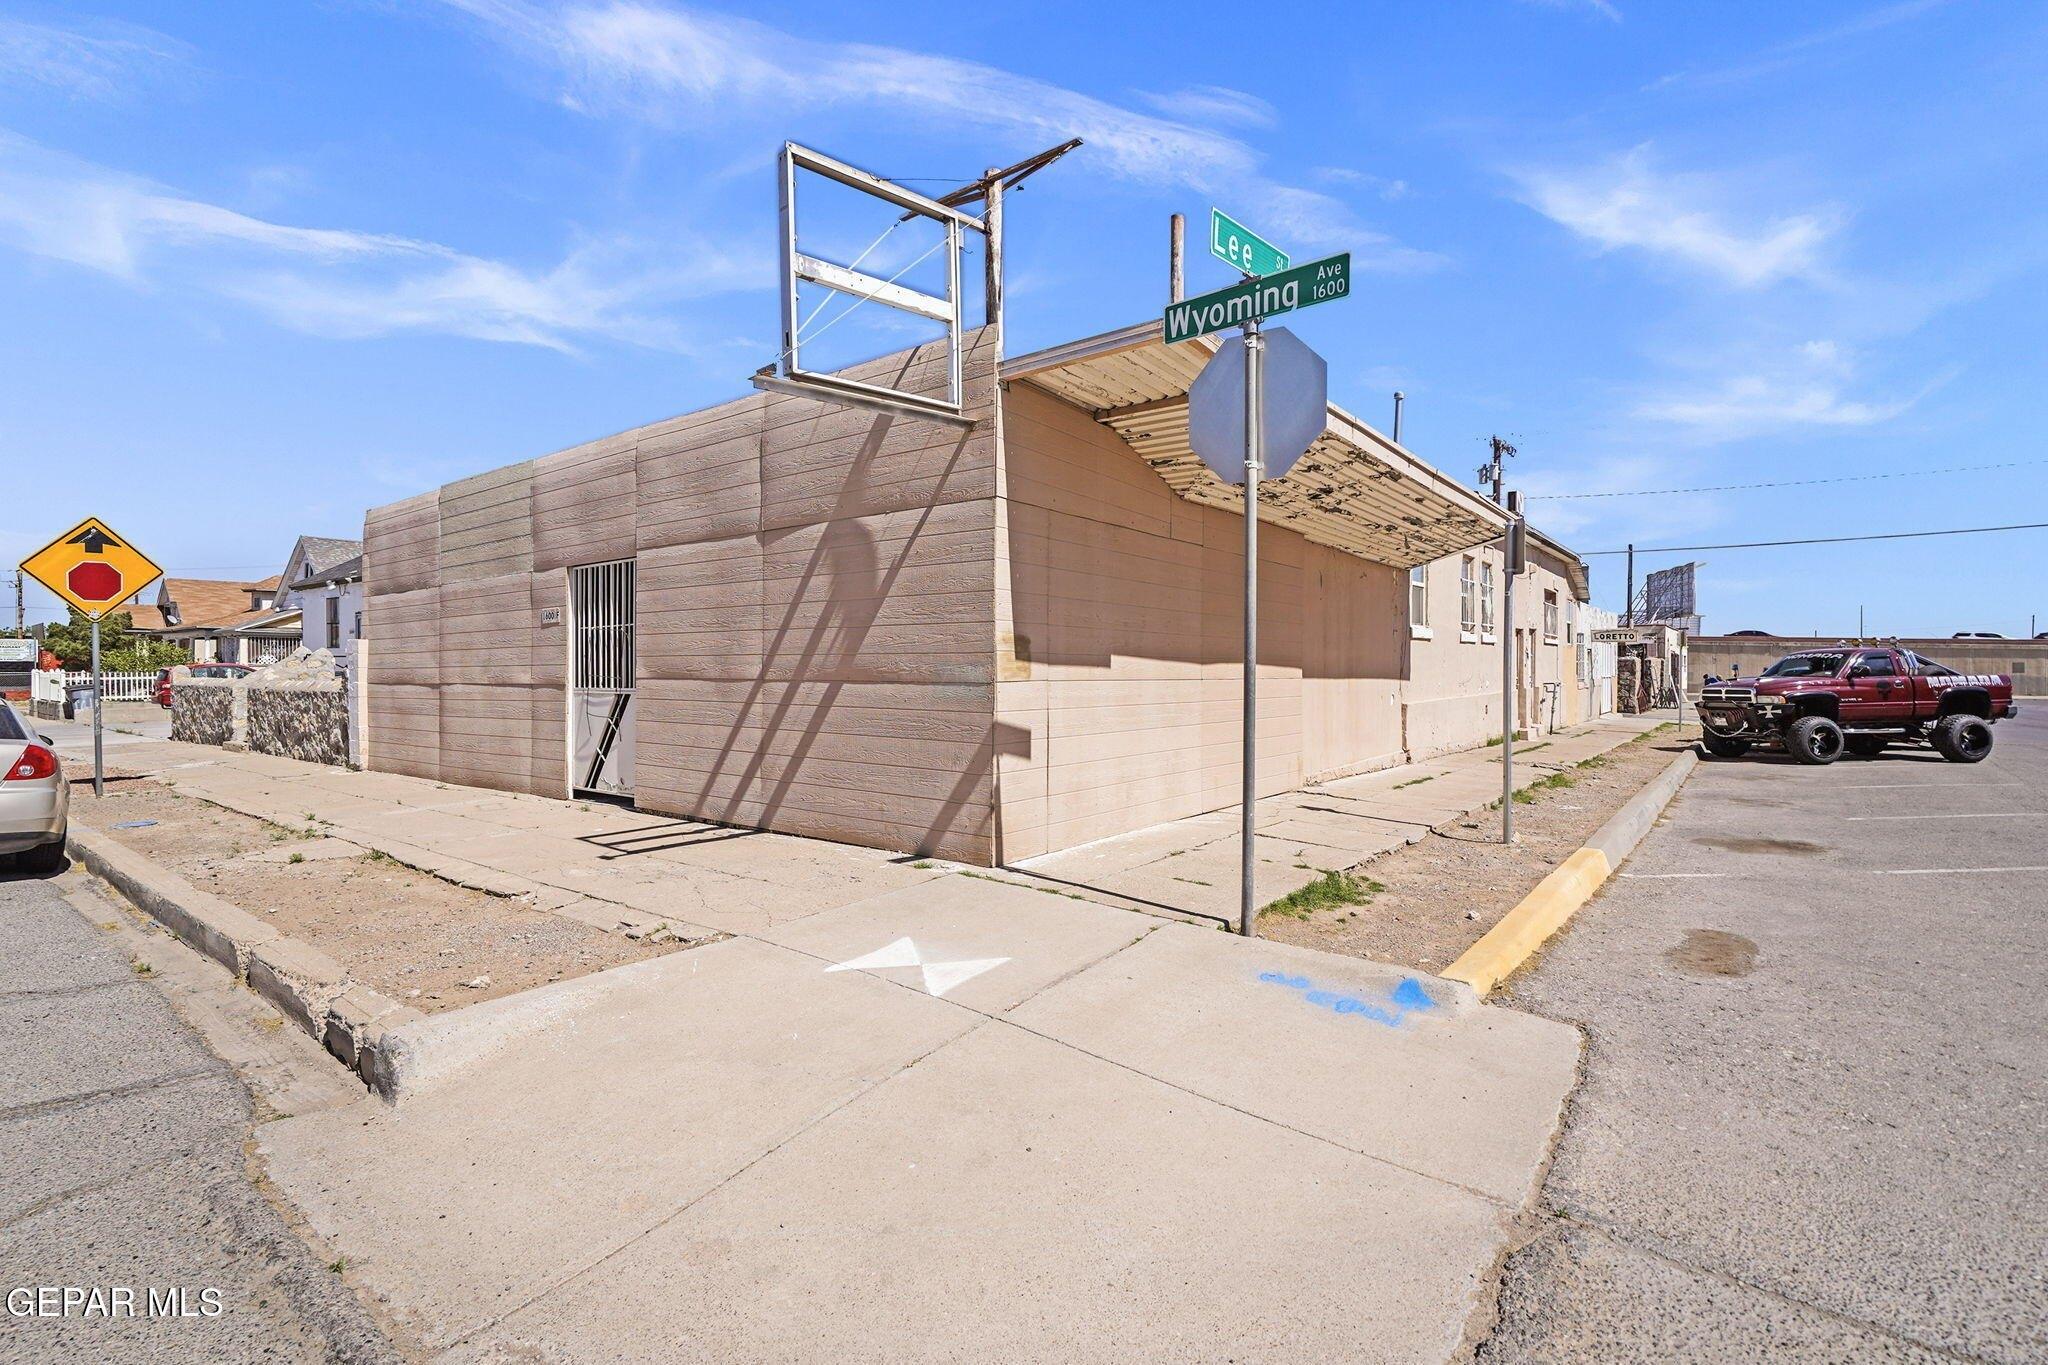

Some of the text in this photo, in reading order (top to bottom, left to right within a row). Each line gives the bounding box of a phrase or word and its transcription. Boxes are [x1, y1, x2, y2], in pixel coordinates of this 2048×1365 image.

[1213, 216, 1252, 269] Lee
[1169, 263, 1342, 338] Wyoming Ave
[1312, 278, 1345, 300] 1600
[1594, 632, 1635, 640] LORETTO
